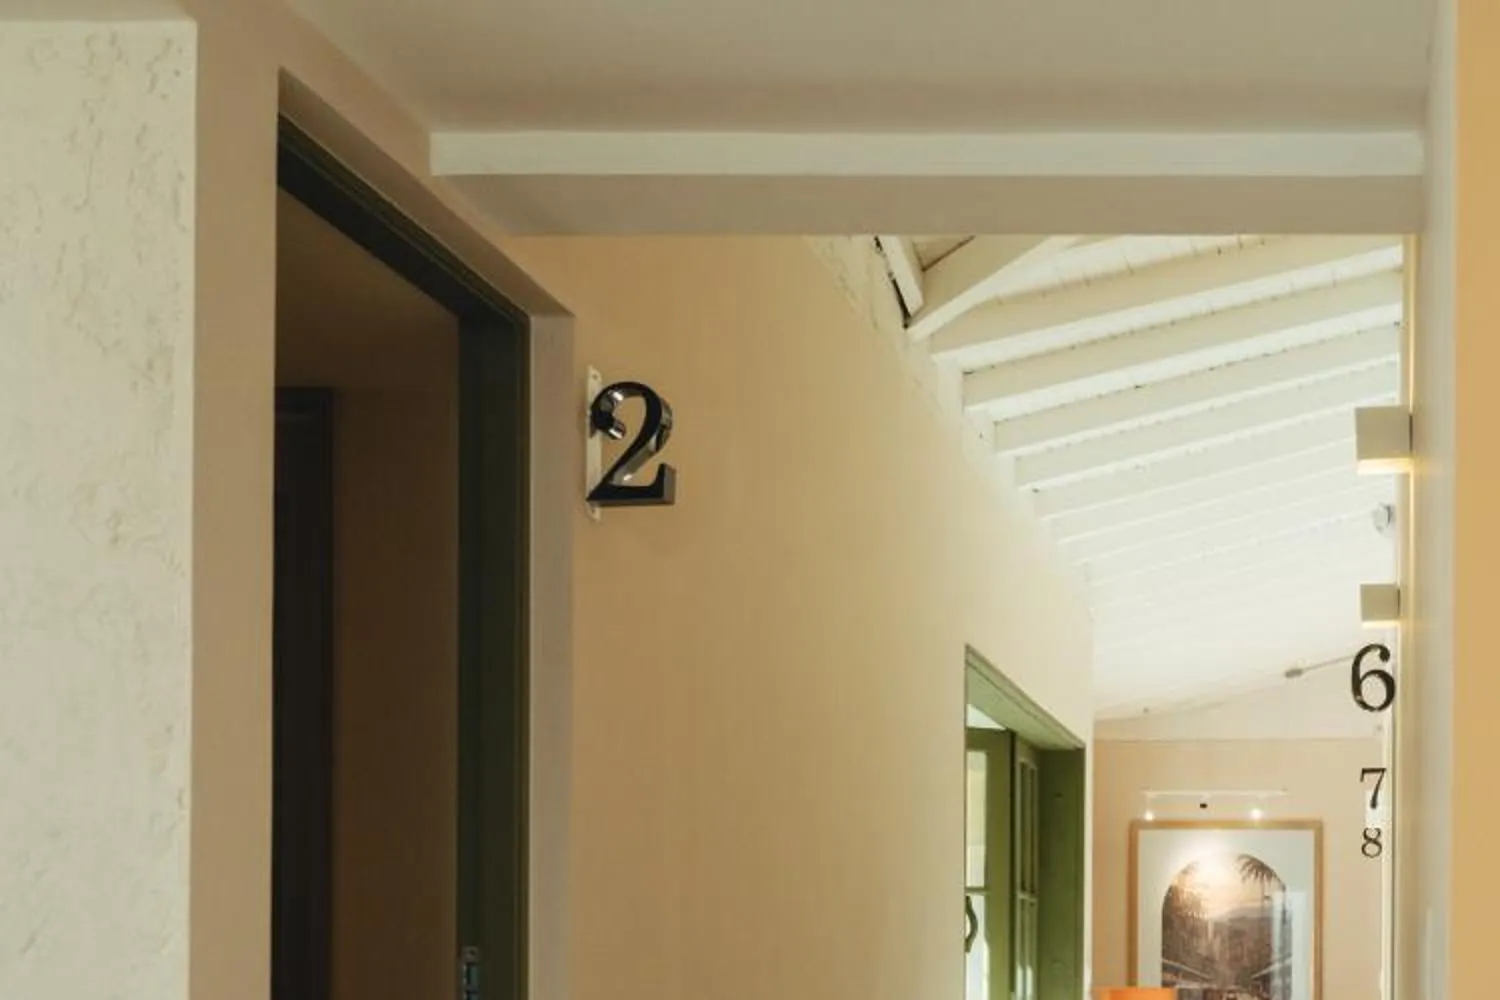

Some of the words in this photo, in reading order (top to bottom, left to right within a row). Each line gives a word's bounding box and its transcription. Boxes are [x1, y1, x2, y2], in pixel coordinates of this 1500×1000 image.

[586, 381, 676, 506] 2
[1351, 643, 1396, 712] 6
[1360, 767, 1387, 809] 7
[1361, 827, 1383, 858] 8
